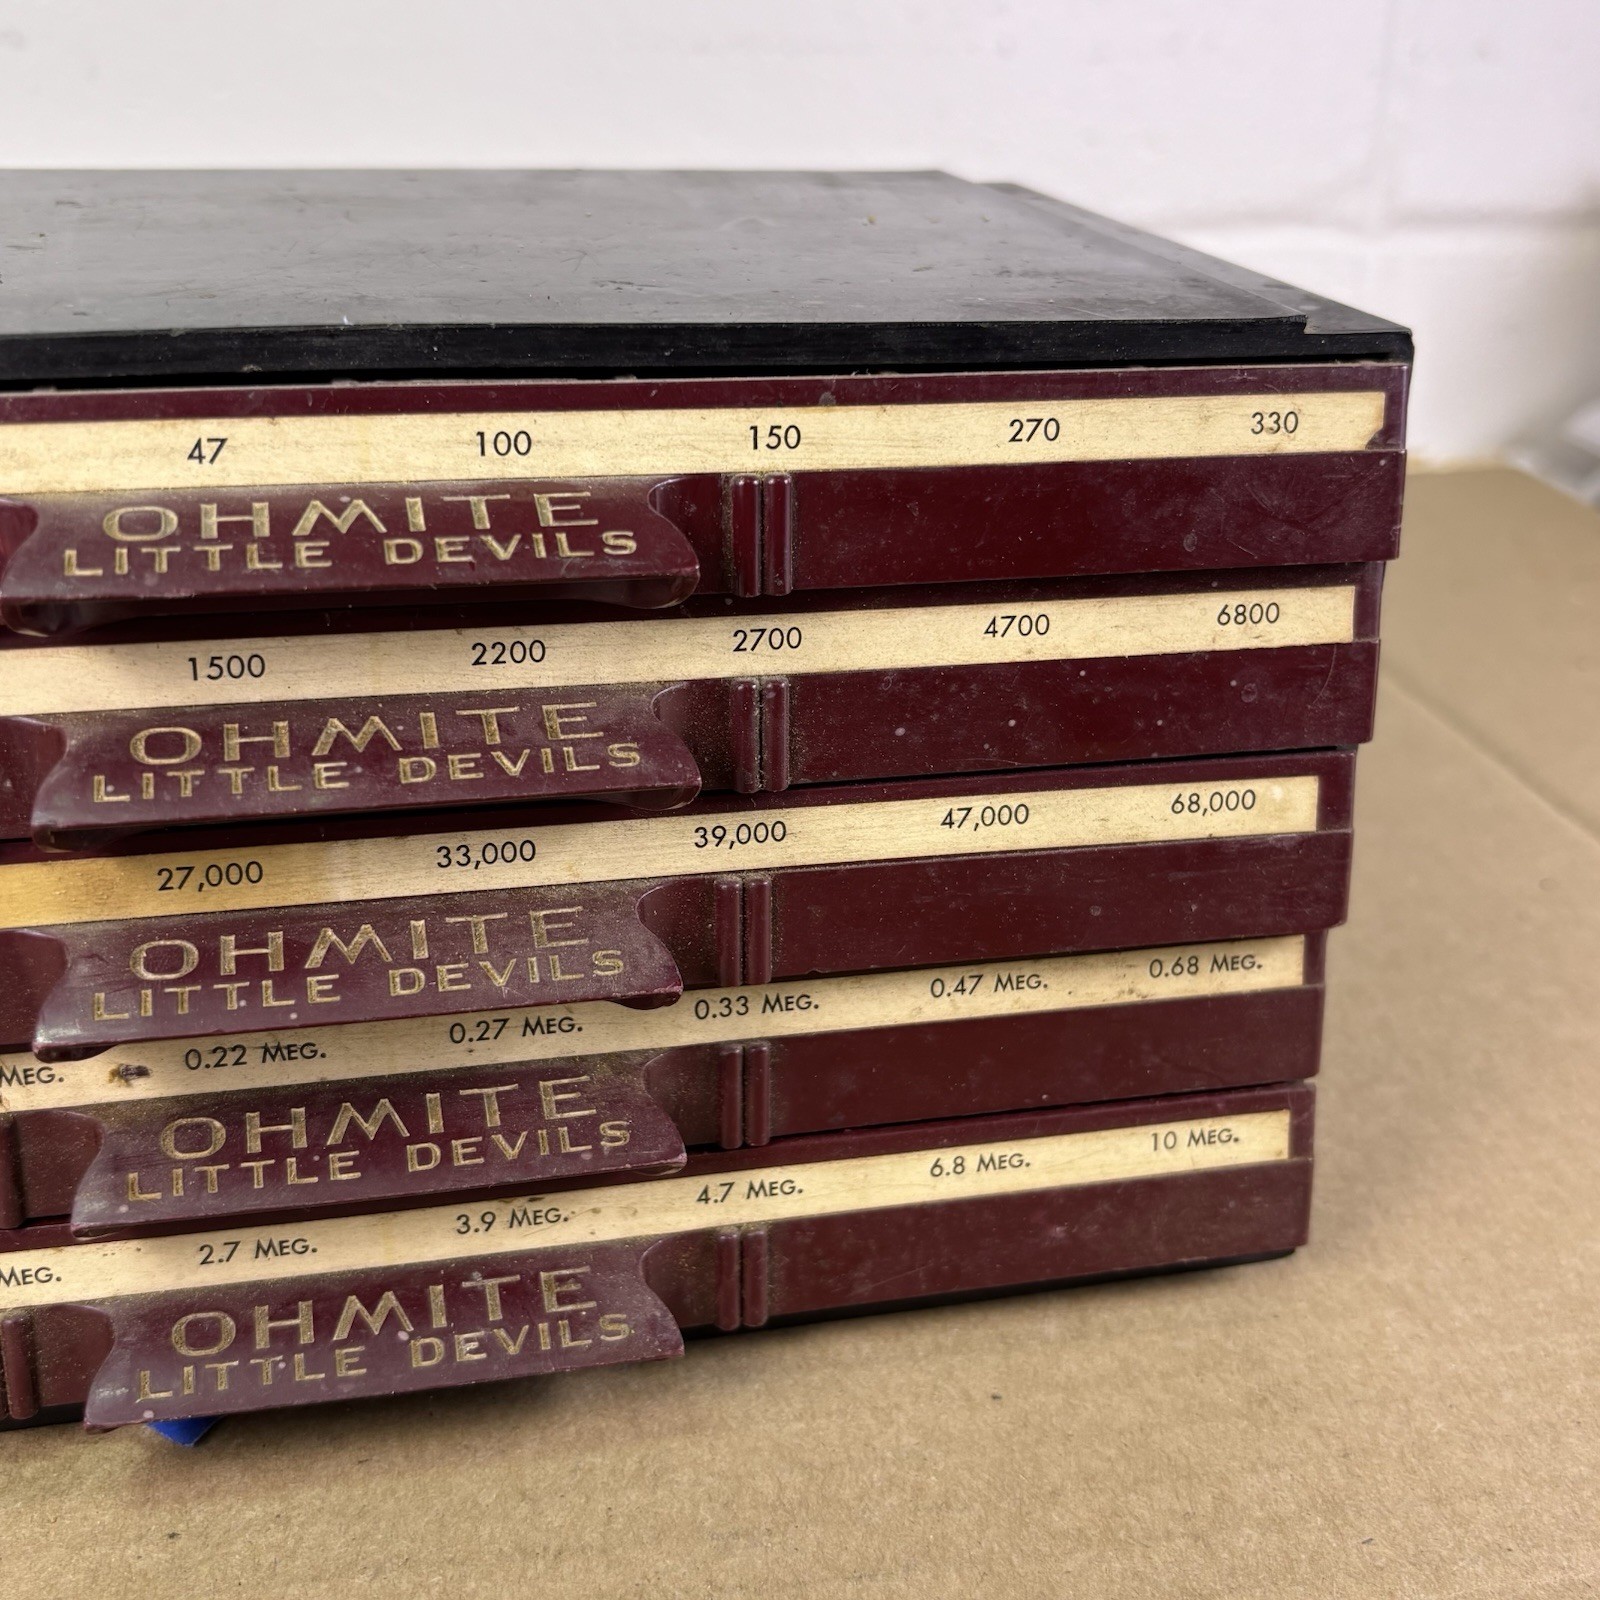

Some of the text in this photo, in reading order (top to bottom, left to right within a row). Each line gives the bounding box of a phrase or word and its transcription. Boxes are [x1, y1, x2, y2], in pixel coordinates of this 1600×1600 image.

[1008, 417, 1061, 443] 270
[1251, 410, 1299, 435] 330
[187, 437, 228, 465] 47
[476, 430, 532, 457] 100
[749, 424, 801, 450] 150
[102, 490, 599, 542] OHMITE
[63, 530, 639, 576] LITTLE DEVILS
[983, 613, 1050, 638] 4700
[1217, 602, 1280, 626] 6800
[471, 639, 546, 666] 2200
[732, 626, 802, 652] 2700
[188, 653, 266, 681] 1500
[129, 701, 604, 765] OHMITE
[93, 742, 642, 802] LITTLE DEVILS
[1171, 789, 1256, 817] 68,000
[940, 803, 1030, 832] 47,000
[694, 820, 787, 850] 39,000
[436, 839, 536, 870] 33,000
[157, 860, 264, 892] 27,000
[129, 906, 590, 981] OHMITE
[1147, 952, 1263, 979] 0.68 MEG.
[93, 949, 625, 1021] LITTLE DEVILS
[928, 972, 1048, 998] 0.47 MEG.
[694, 992, 819, 1020] 0.33 MEG.
[449, 1015, 583, 1044] 0.27 MEG.
[184, 1041, 327, 1071] 0.22 MEG.
[160, 1076, 597, 1160] OHMITE
[1151, 1128, 1240, 1152] 10 MEG.
[127, 1120, 631, 1201] LITTLE DEVILS
[930, 1153, 1031, 1178] 6.8 MEG.
[696, 1179, 803, 1205] 4.7 MEG.
[456, 1207, 569, 1235] 3.9 MEG.
[198, 1238, 317, 1266] 2.7 MEG.
[171, 1266, 597, 1356] OHMITE
[138, 1314, 630, 1400] LITTLE DEVILS
